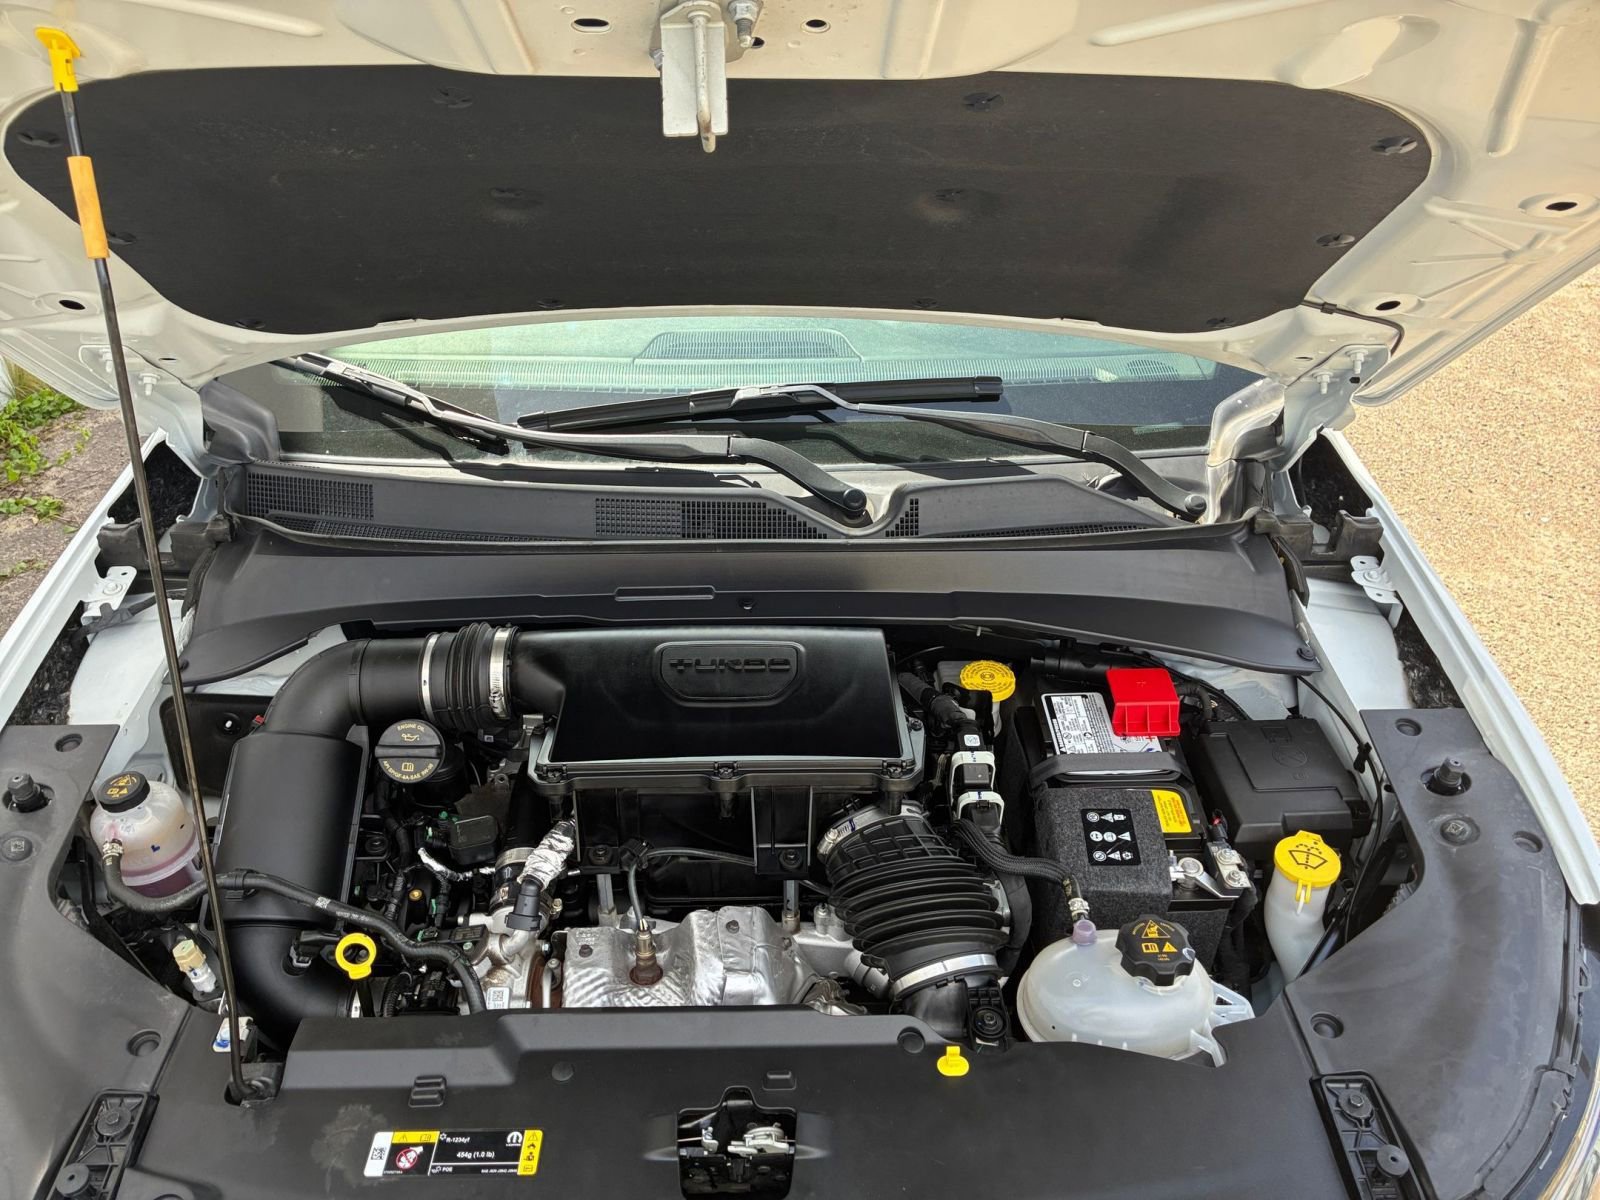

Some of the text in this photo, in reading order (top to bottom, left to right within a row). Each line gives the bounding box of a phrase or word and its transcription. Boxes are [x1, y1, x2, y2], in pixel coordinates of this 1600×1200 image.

[397, 723, 416, 731] ENGINE
[473, 1151, 485, 1159] (1.0
[486, 1151, 495, 1159] lb)
